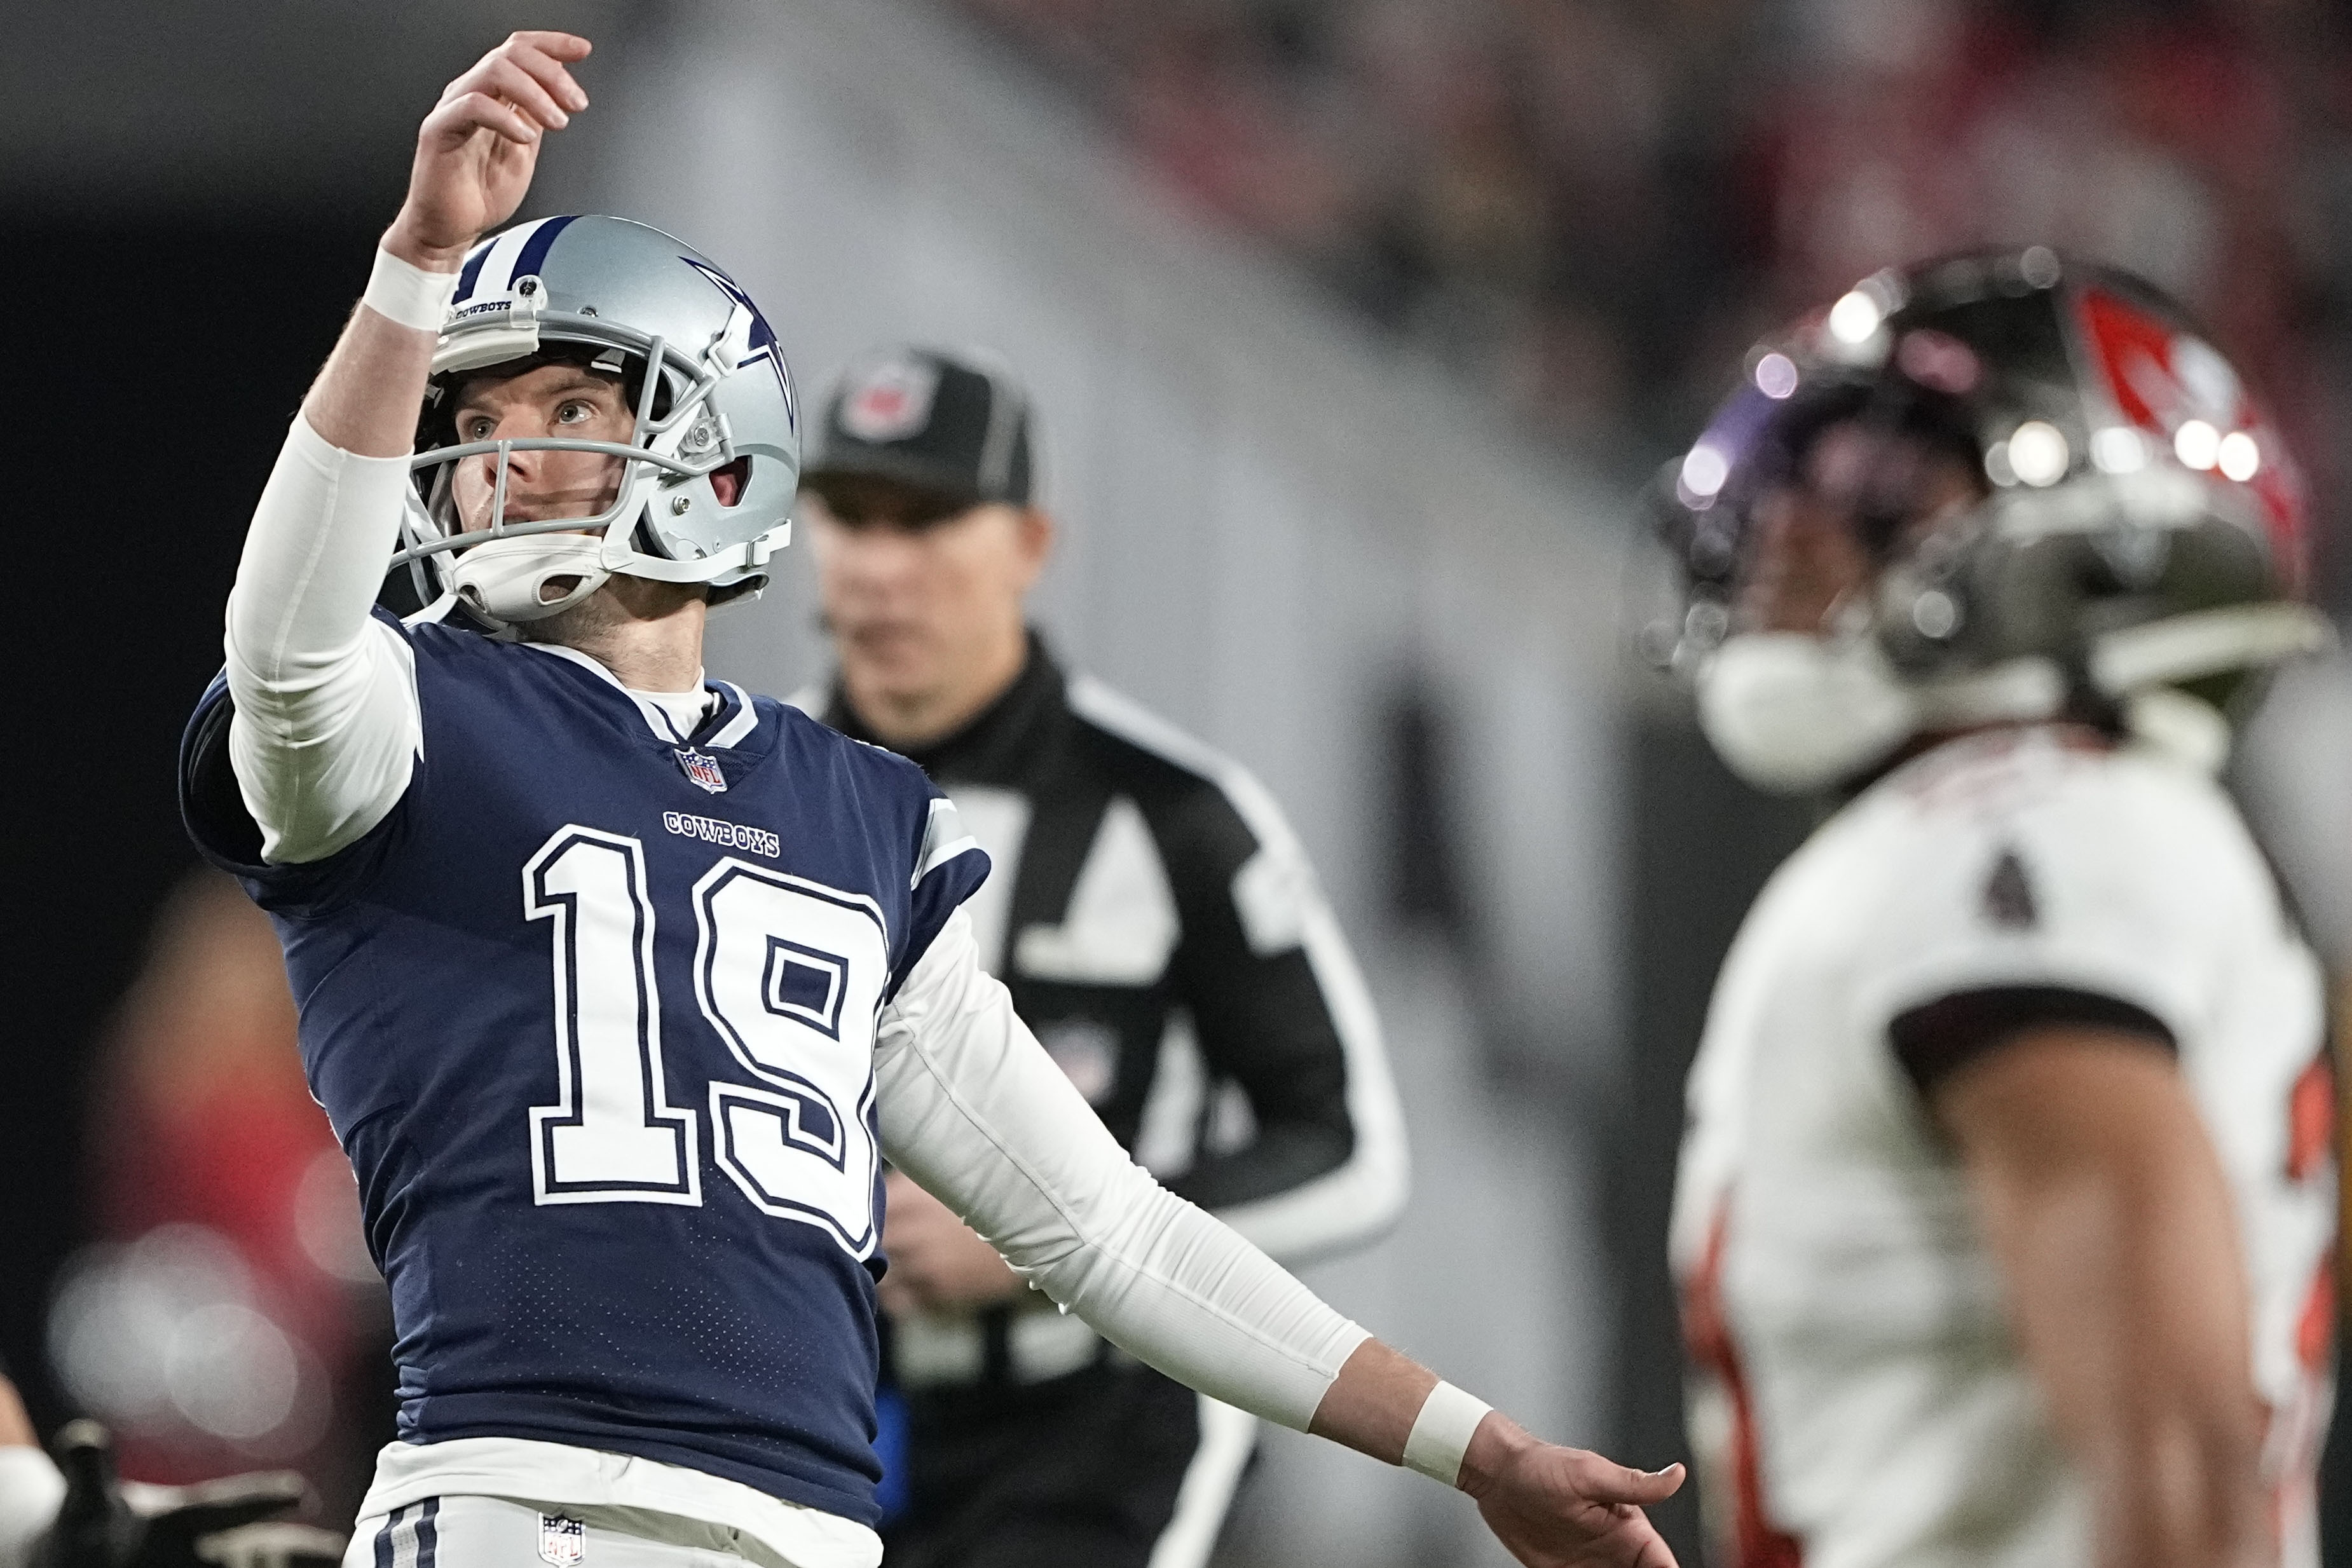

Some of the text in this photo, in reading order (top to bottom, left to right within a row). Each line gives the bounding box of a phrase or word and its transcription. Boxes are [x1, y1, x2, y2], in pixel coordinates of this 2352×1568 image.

[456, 301, 511, 319] COWBOYS
[691, 765, 720, 784] NFL
[663, 812, 781, 858] COWBOYS
[522, 823, 890, 1263] 19
[549, 1536, 578, 1558] NFL
